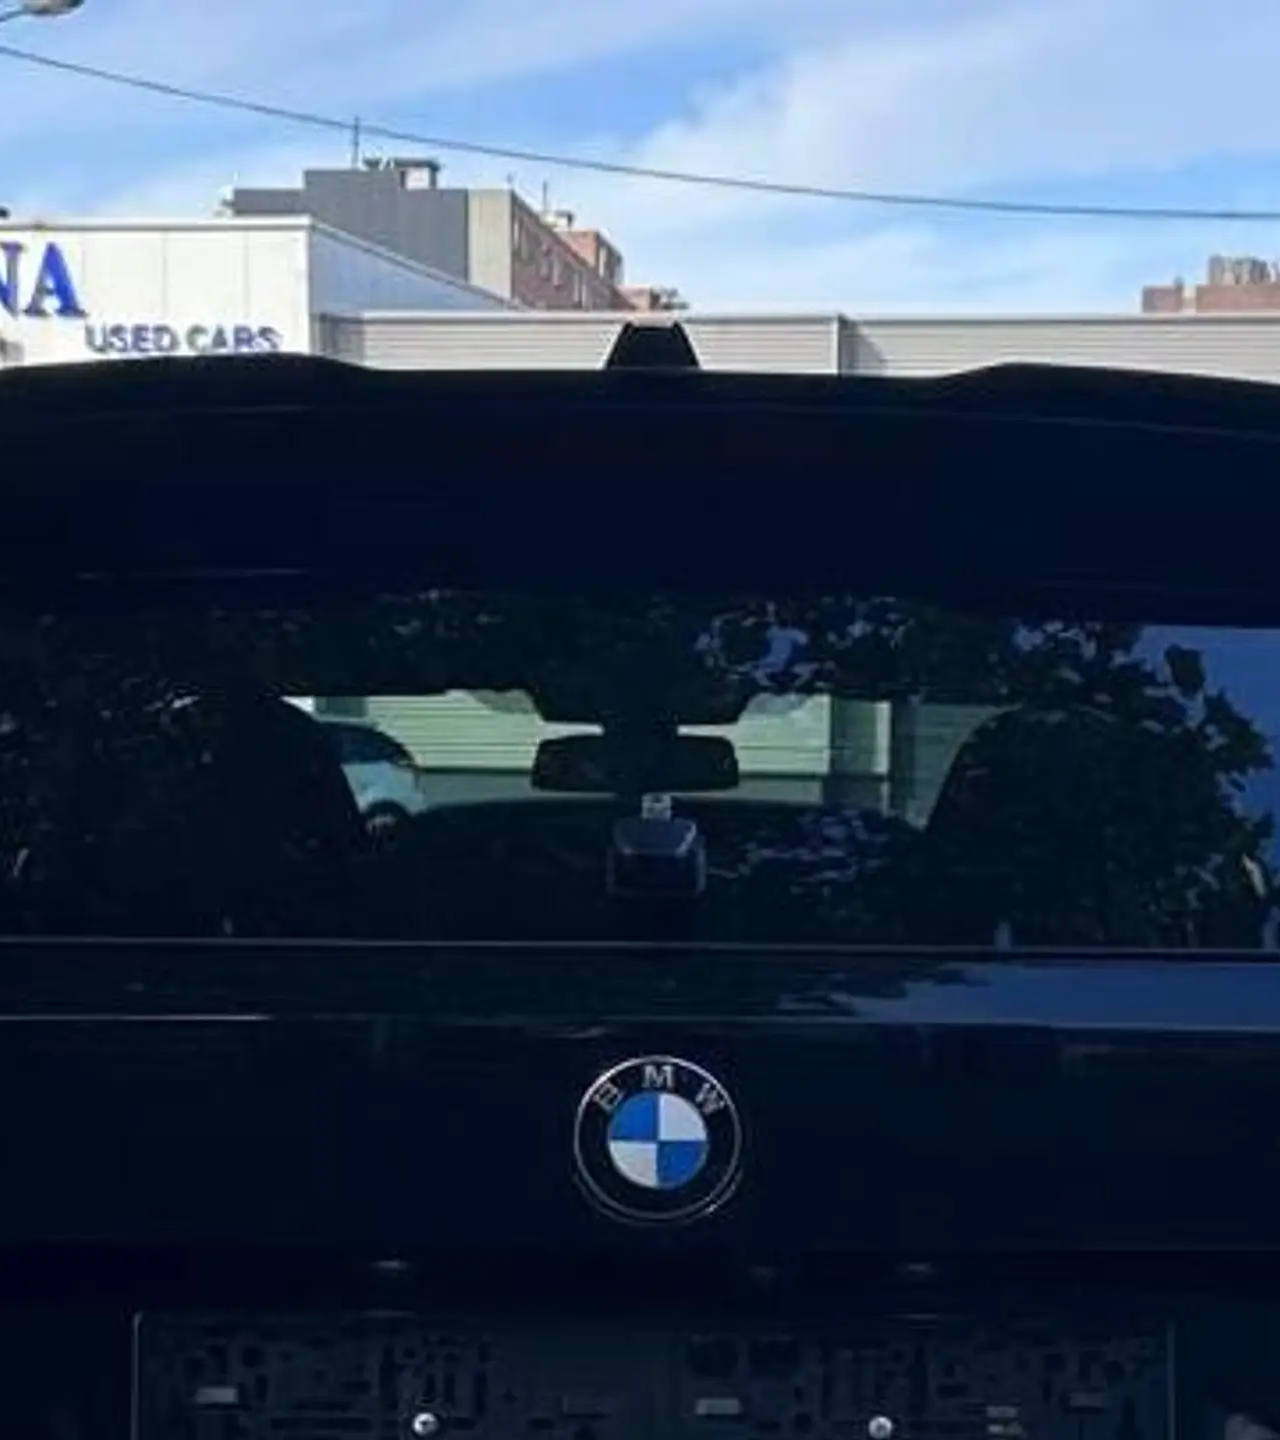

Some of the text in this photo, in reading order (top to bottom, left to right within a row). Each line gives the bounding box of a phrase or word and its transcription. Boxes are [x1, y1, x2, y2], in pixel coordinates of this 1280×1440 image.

[84, 323, 284, 353] USED CARS
[592, 1065, 726, 1116] BMW
